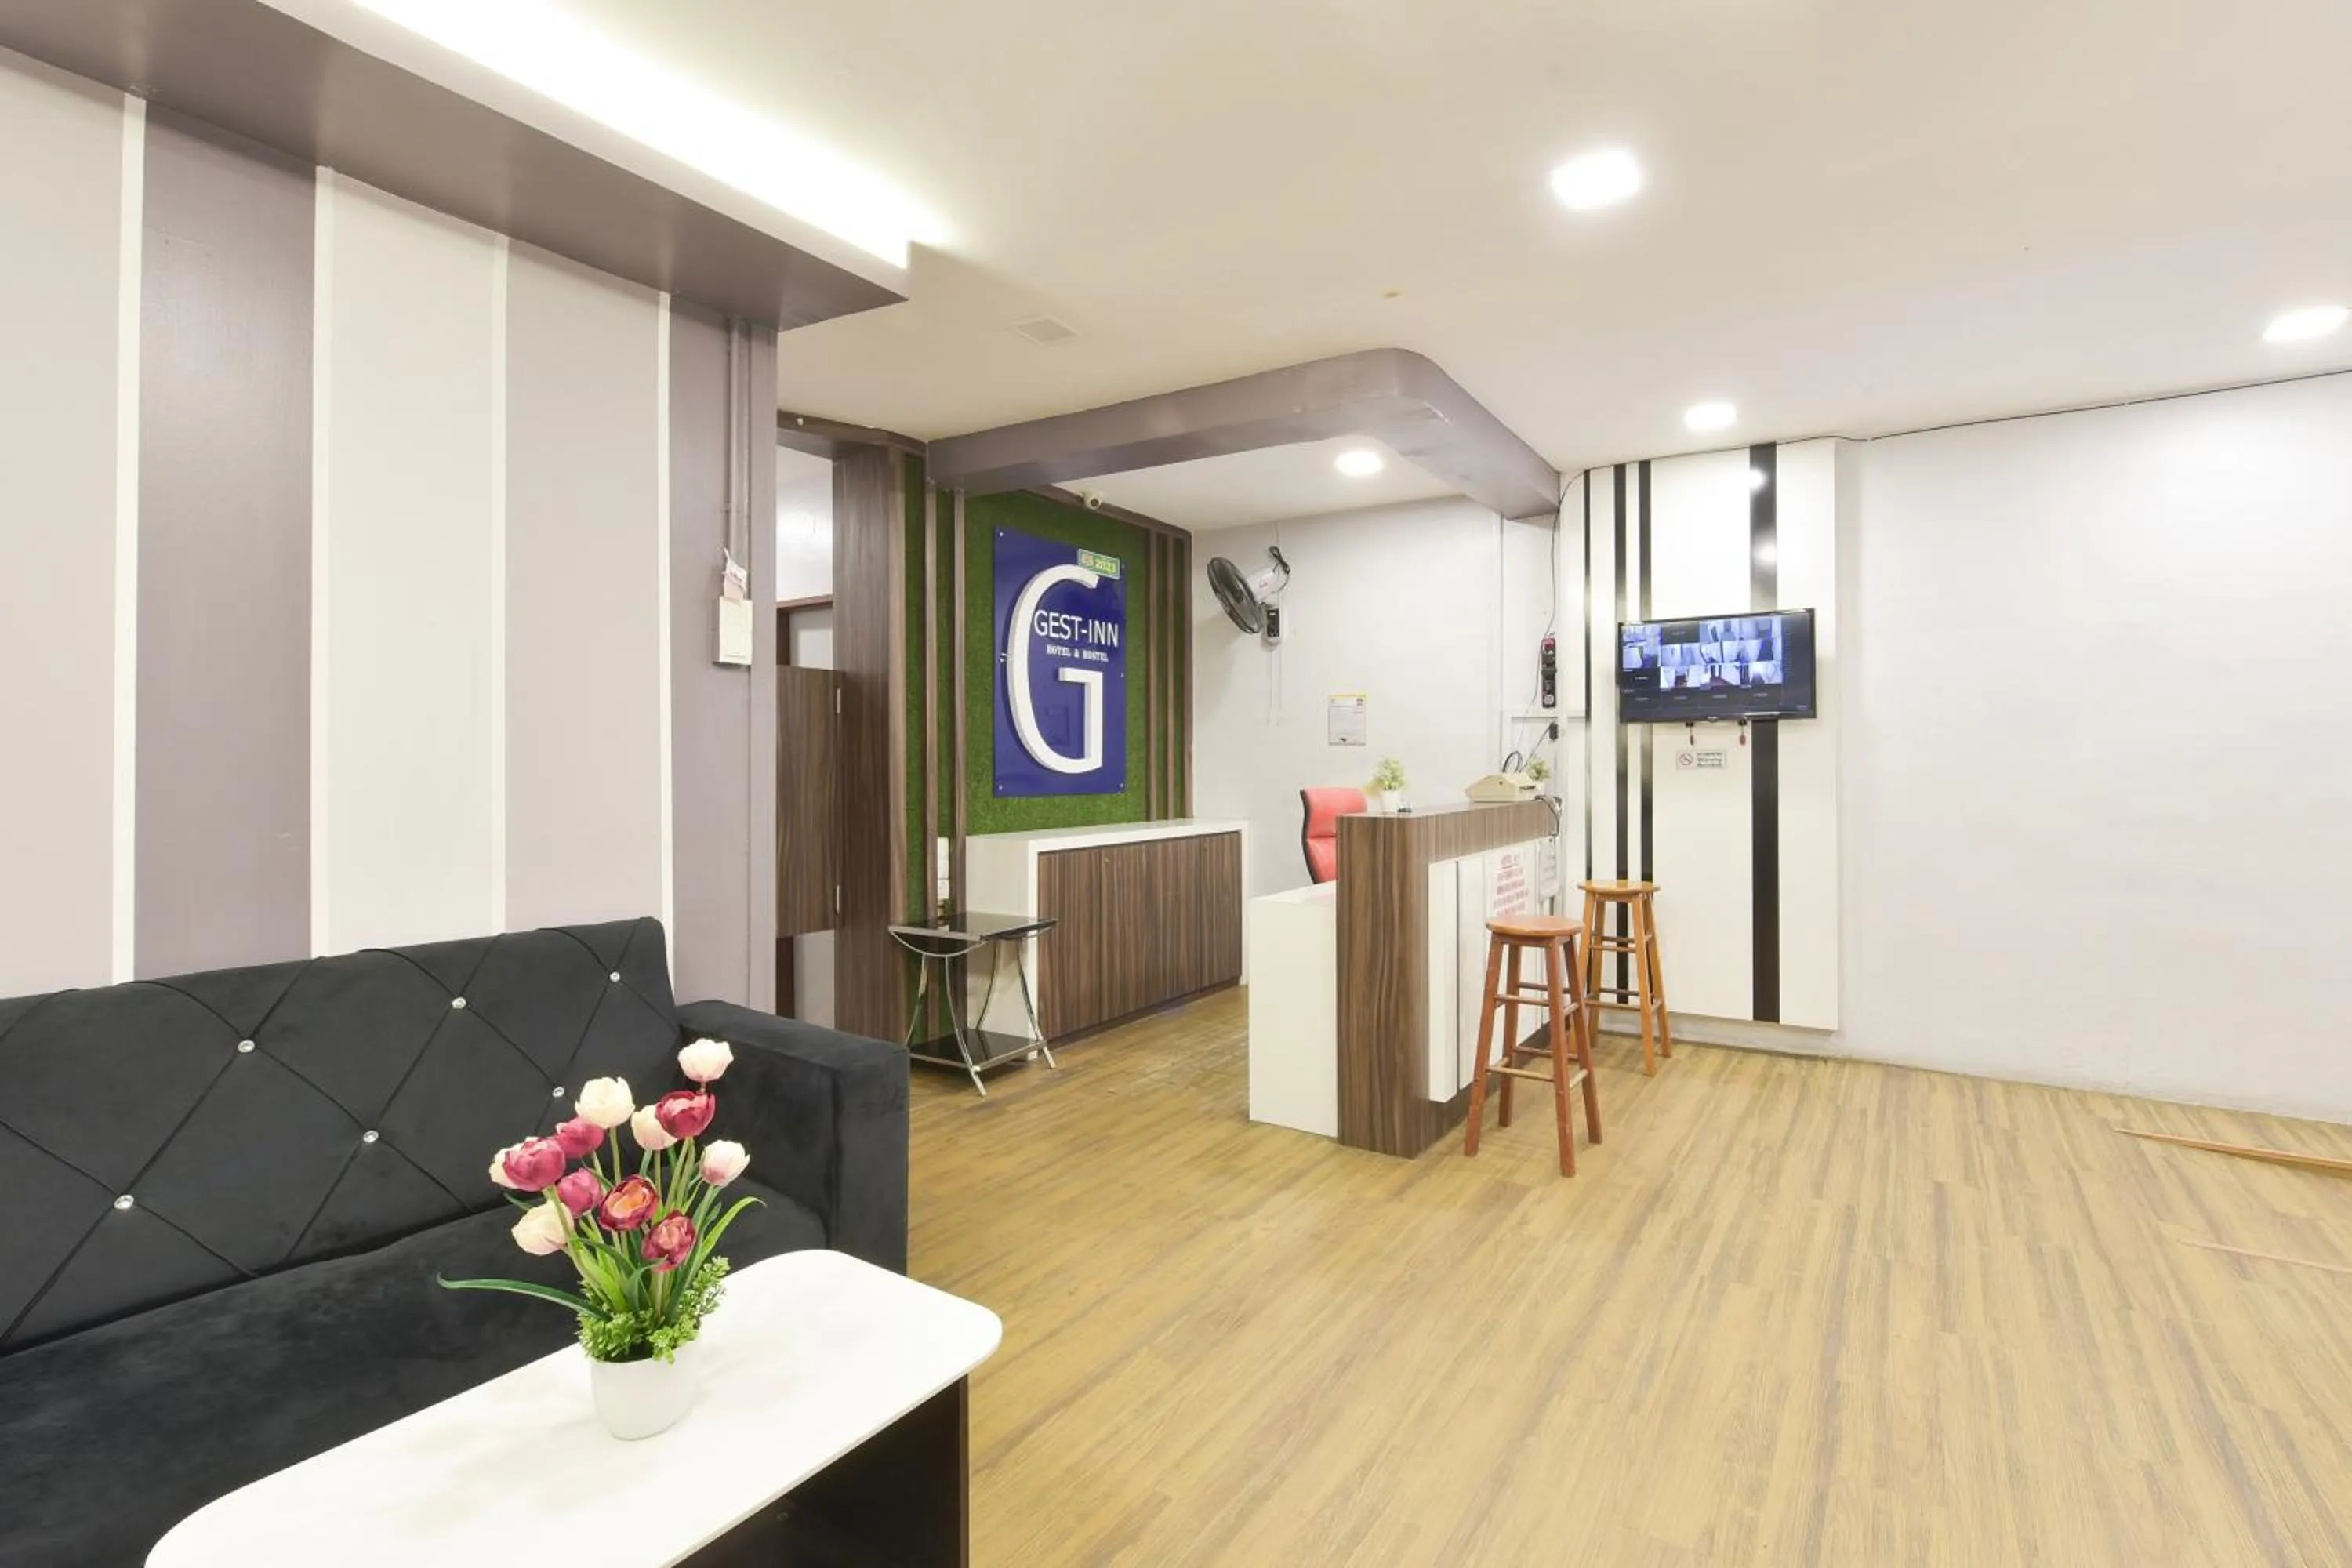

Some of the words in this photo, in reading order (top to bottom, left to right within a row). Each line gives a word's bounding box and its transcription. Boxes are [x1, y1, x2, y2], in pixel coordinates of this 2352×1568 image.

[1034, 609, 1119, 648] GEST-INN
[1007, 564, 1103, 774] G
[1046, 644, 1071, 657] HOTEL
